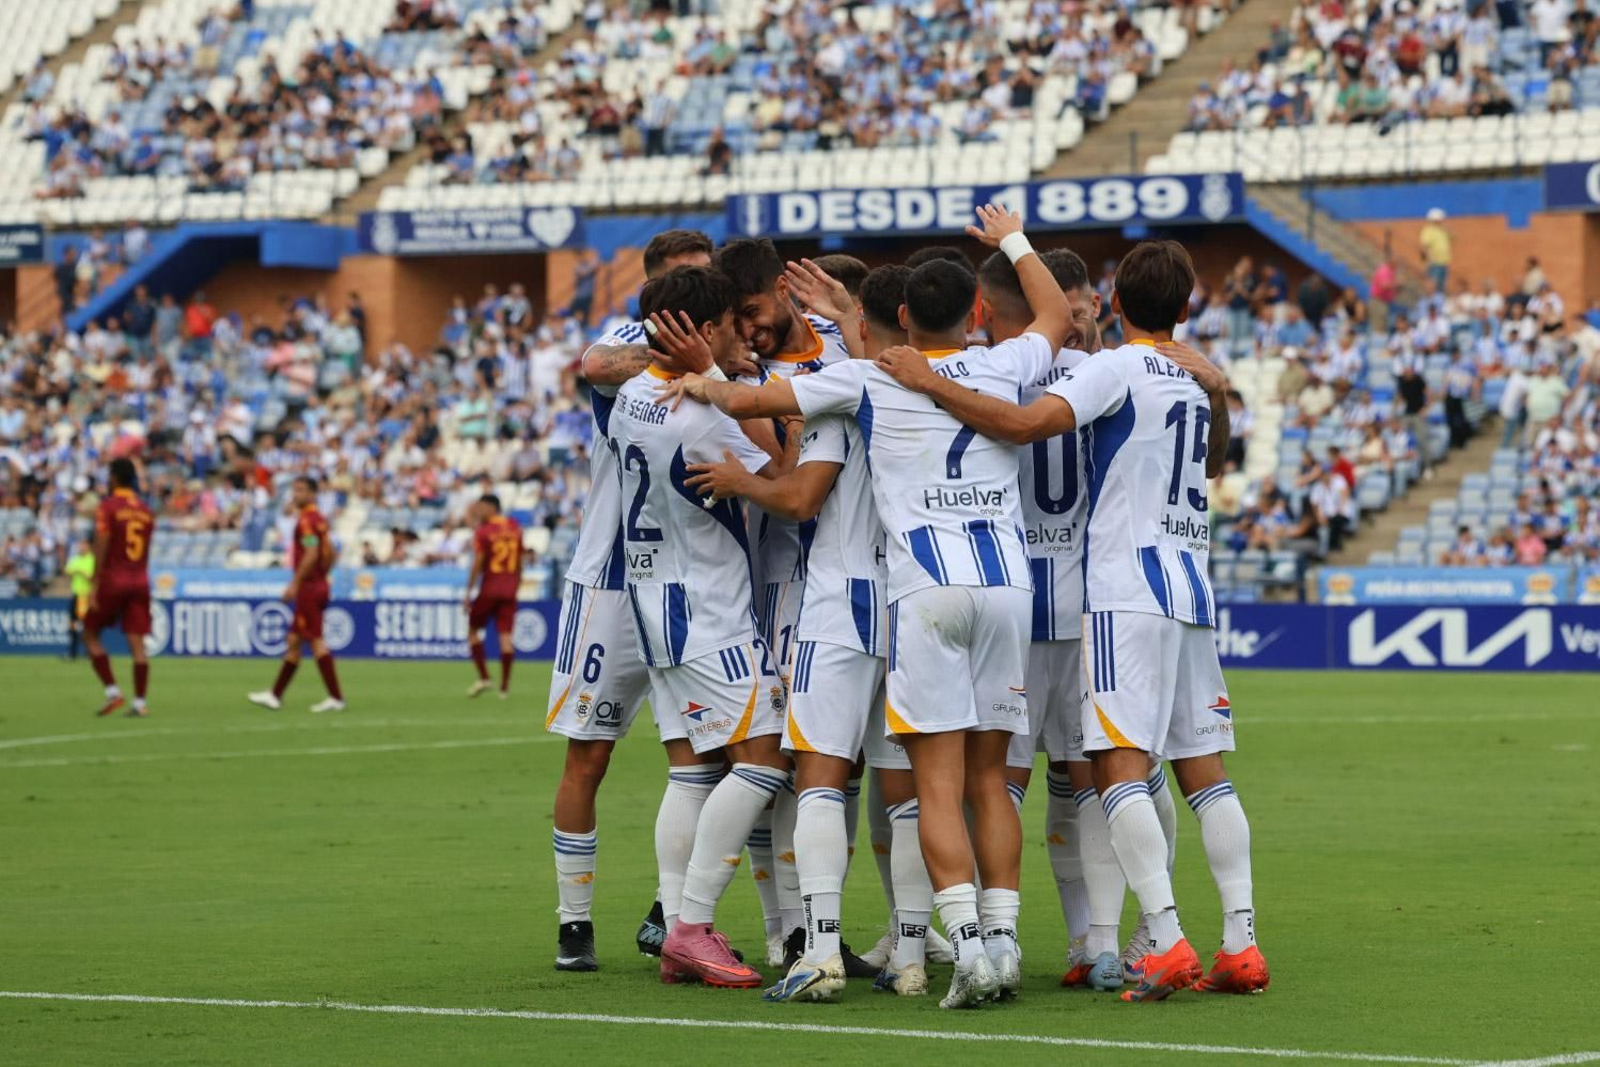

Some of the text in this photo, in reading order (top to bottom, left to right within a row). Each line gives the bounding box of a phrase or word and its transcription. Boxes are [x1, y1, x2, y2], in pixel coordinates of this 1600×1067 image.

[779, 177, 1189, 231] DESDE 1889
[1165, 401, 1211, 512] 15
[126, 520, 143, 561] 5
[1026, 523, 1071, 544] elva
[490, 541, 517, 573] 21
[0, 609, 70, 633] VERSU
[583, 643, 605, 684] 6
[992, 703, 1021, 716] GRUPO
[903, 924, 925, 938] FS
